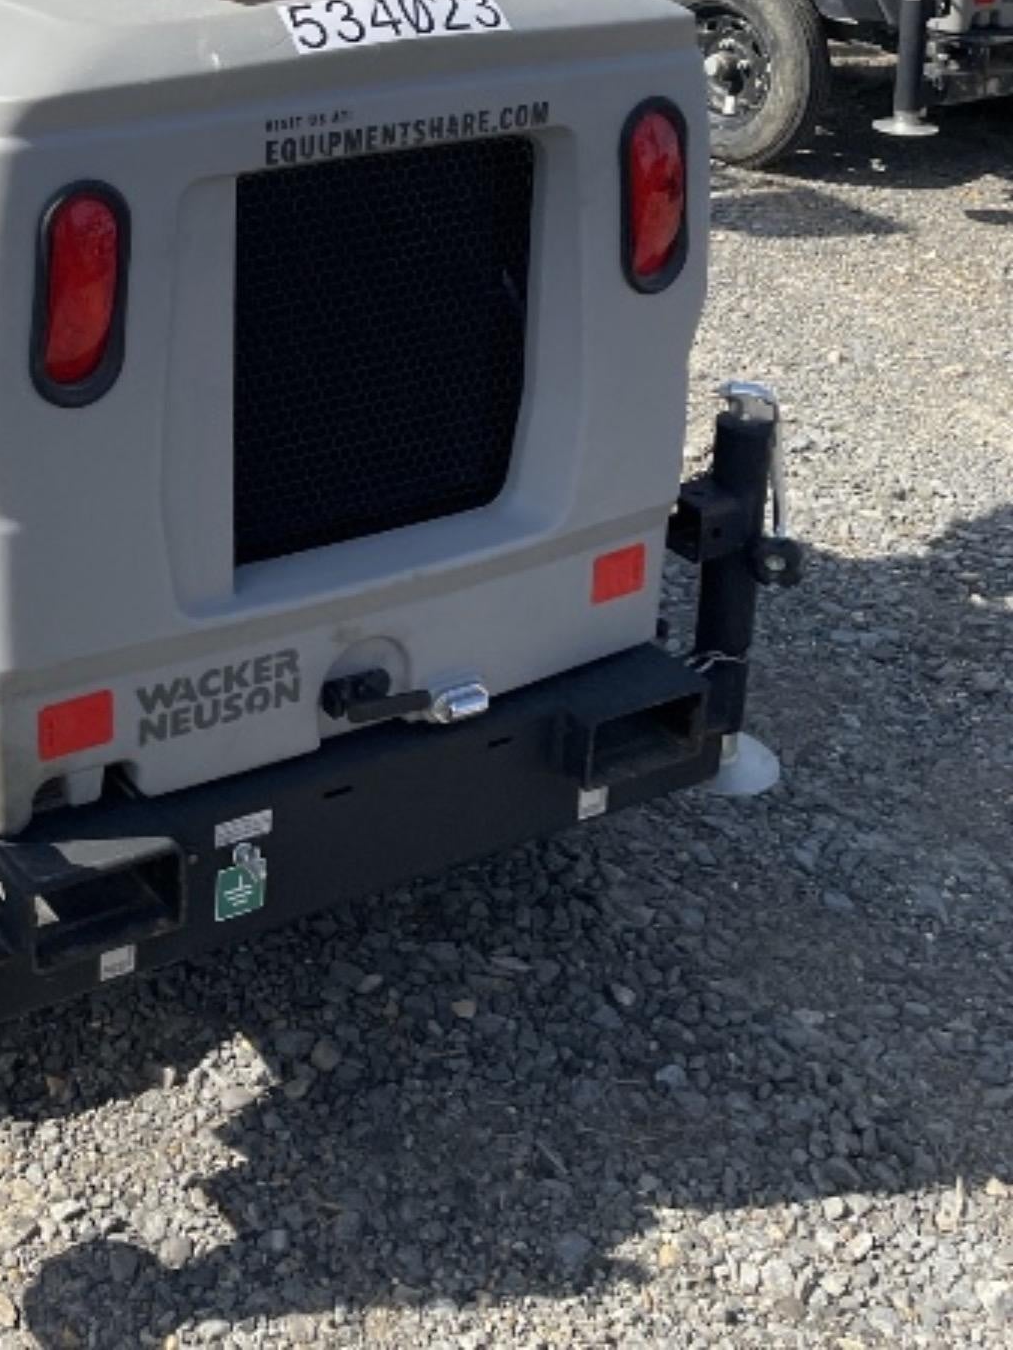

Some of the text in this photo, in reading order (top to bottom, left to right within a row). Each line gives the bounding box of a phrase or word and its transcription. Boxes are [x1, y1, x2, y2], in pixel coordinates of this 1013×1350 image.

[265, 101, 549, 166] EQUIPMENTSHARE.COM
[136, 648, 300, 715] WACKER
[139, 677, 301, 748] NEUSON
